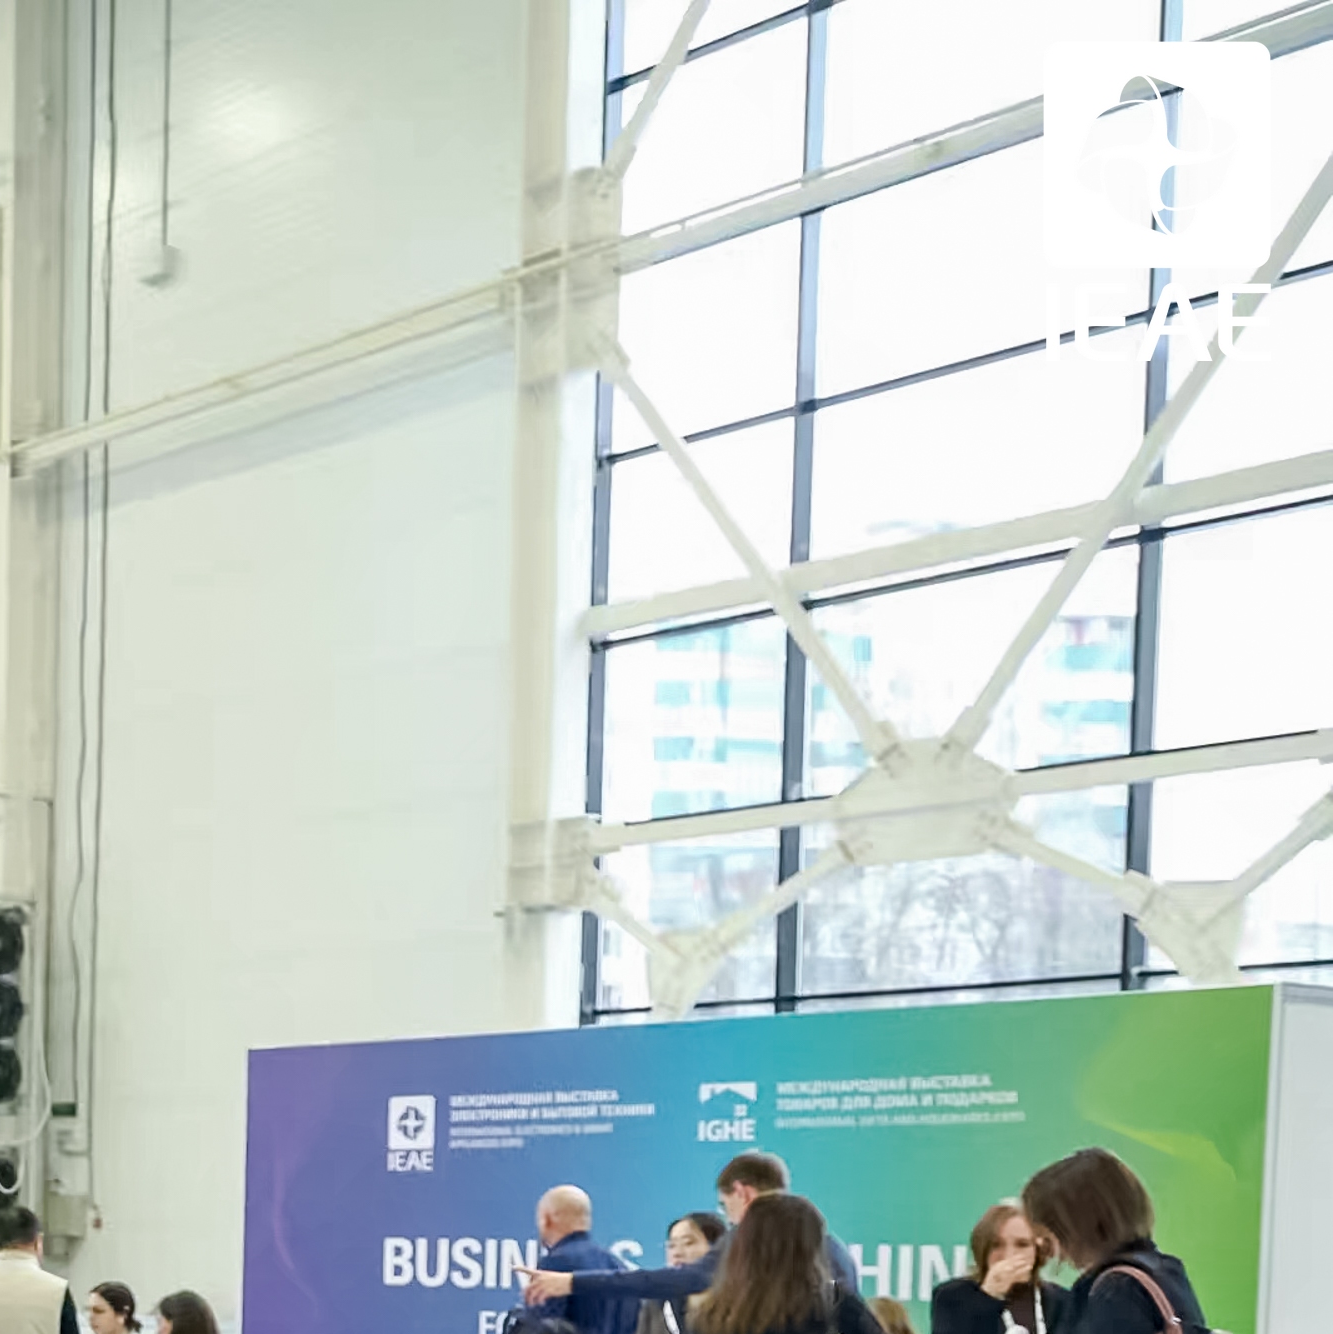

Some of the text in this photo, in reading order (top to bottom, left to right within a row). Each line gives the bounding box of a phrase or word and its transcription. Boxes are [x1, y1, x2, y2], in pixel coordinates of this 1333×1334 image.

[697, 1119, 756, 1142] IGHE
[387, 1150, 434, 1172] IEAE
[848, 1243, 970, 1302] HIN
